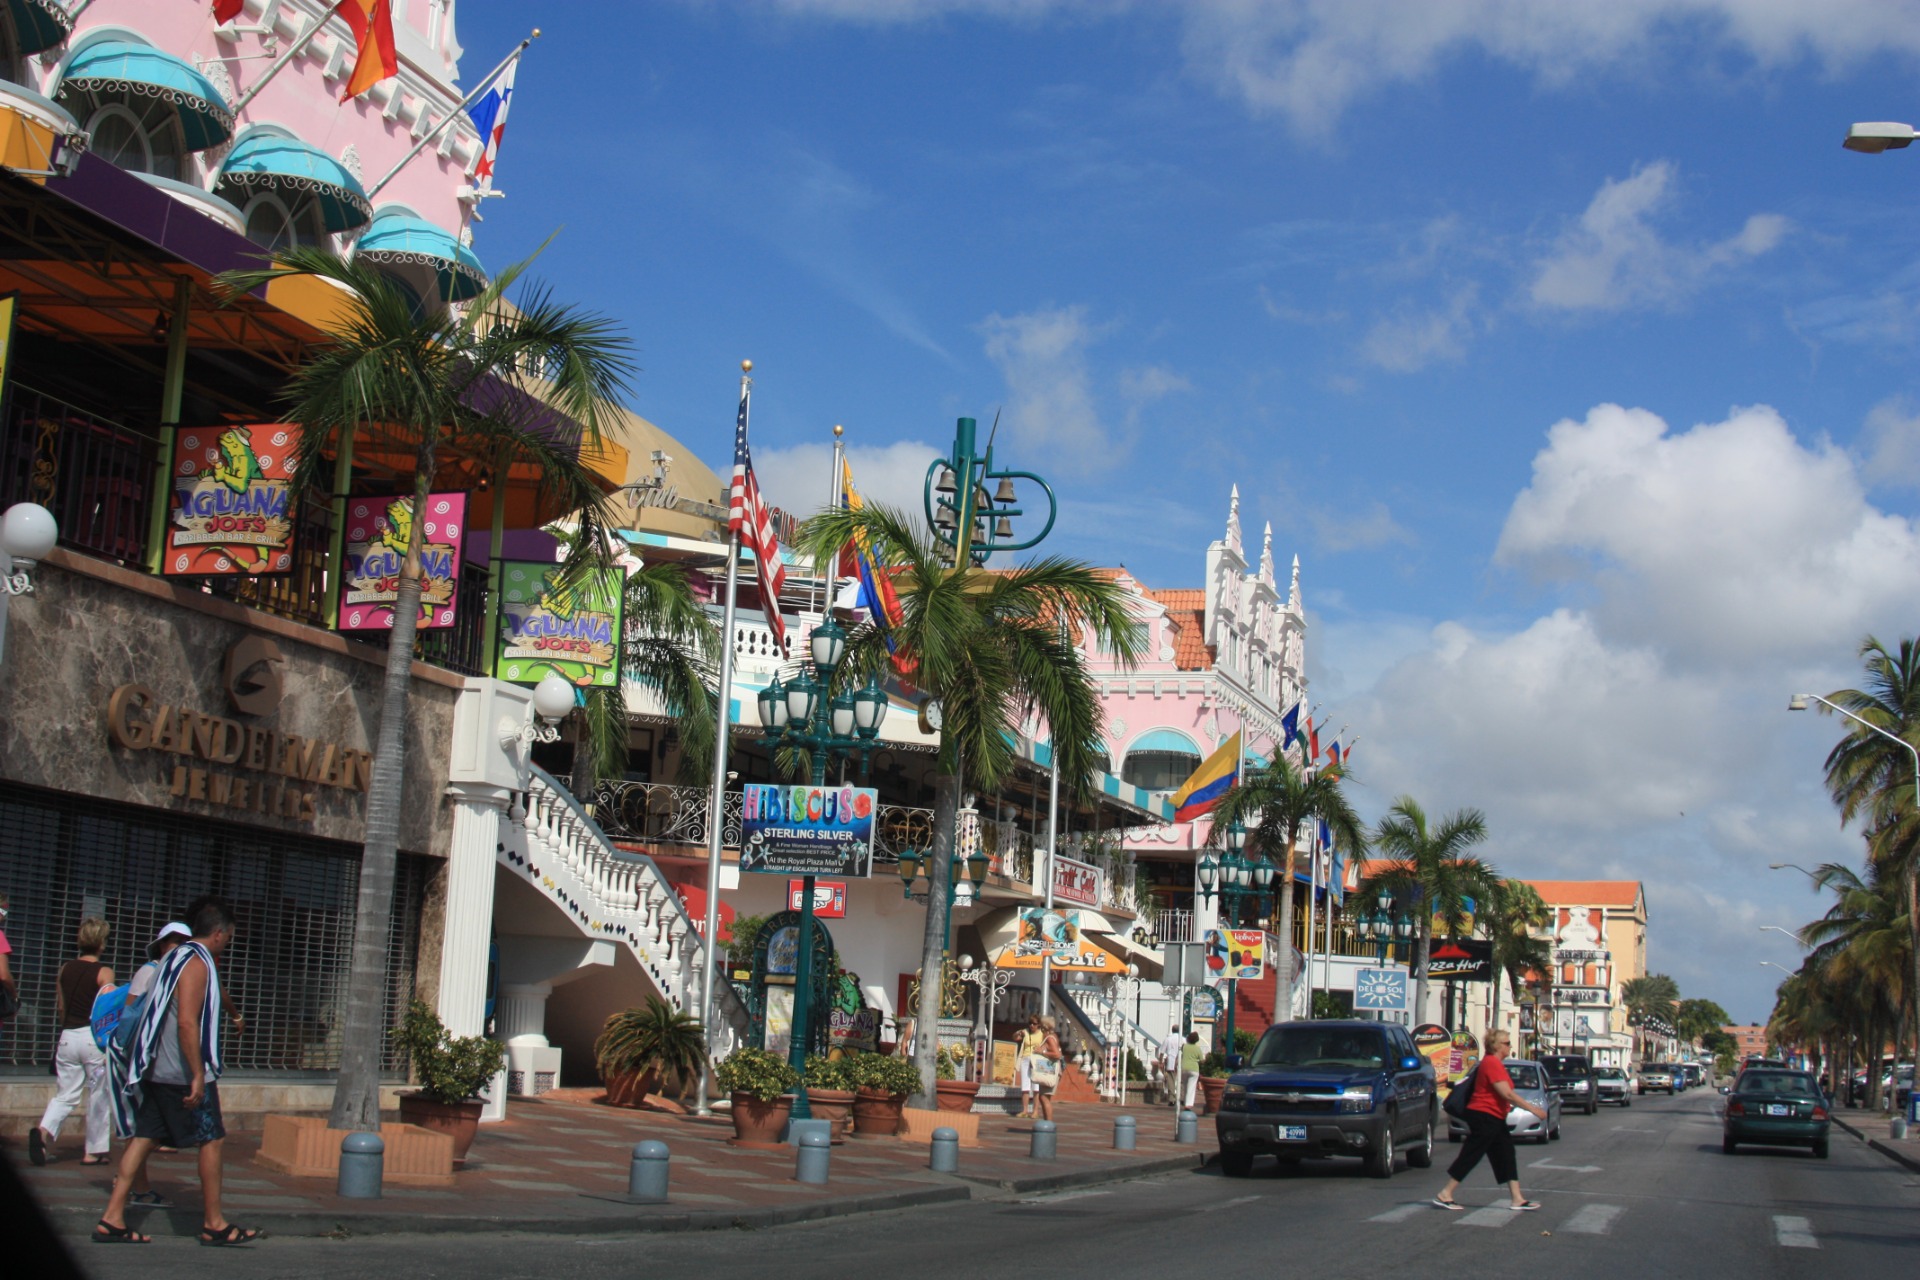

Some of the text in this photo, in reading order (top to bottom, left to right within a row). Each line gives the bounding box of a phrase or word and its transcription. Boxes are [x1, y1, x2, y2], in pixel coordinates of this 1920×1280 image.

[178, 486, 290, 521] IGUANA
[177, 533, 225, 544] CARIBBEAN
[227, 533, 245, 542] BAR
[255, 535, 280, 545] GRILL
[350, 550, 452, 580] IGUNA
[507, 613, 611, 646] IGUANA
[107, 683, 374, 793] GANDELMAN
[763, 827, 853, 841] STERLING SILVER
[769, 856, 776, 864] At
[788, 857, 806, 866] Royal
[806, 857, 824, 865] Plaza
[825, 858, 838, 866] Mall
[1456, 959, 1485, 971] Hut
[1358, 985, 1404, 994] DEL SOL
